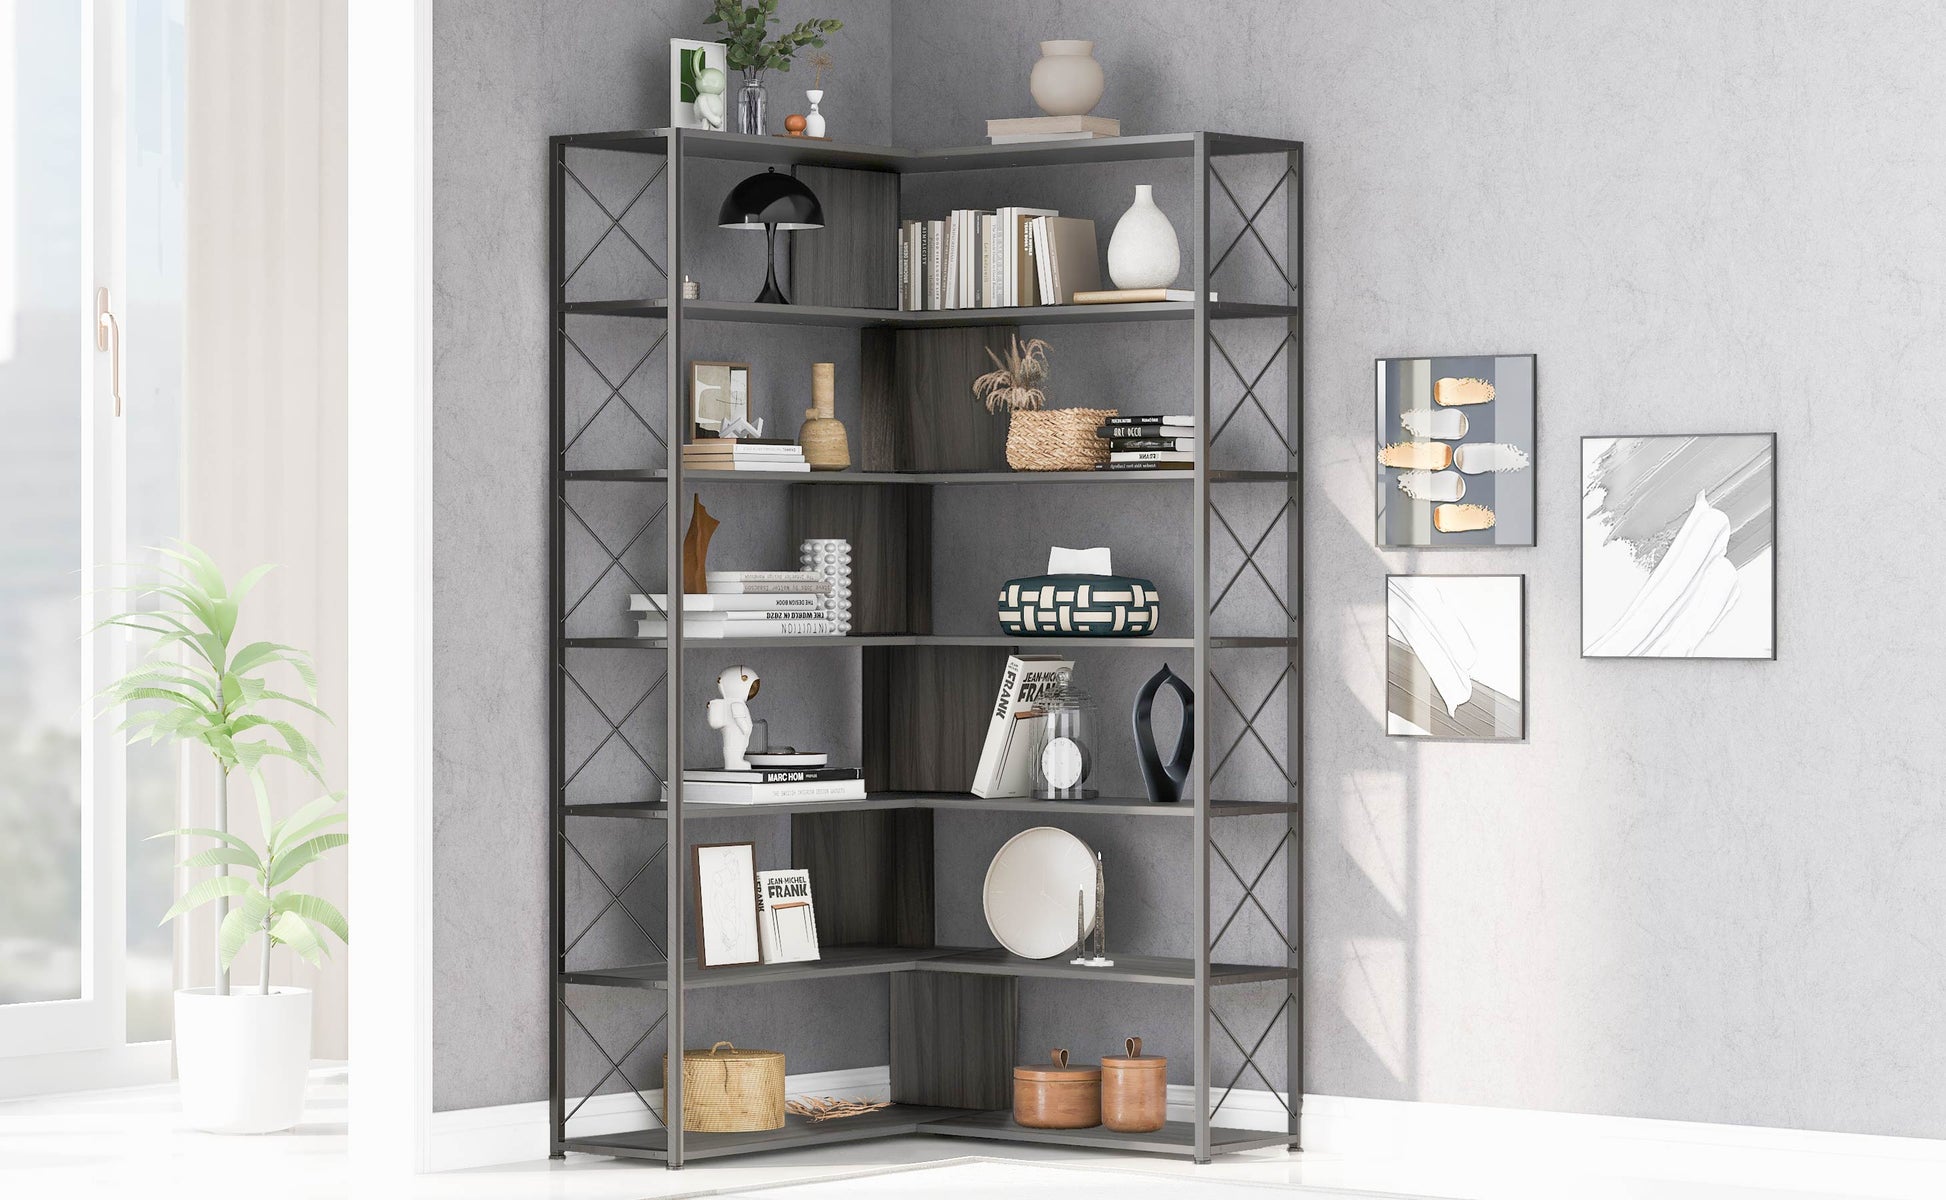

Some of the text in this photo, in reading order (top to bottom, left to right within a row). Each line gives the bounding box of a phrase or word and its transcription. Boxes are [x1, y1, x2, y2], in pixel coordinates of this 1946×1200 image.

[1113, 427, 1142, 437] ART DECO
[766, 611, 825, 619] THE WORLD IN 2020
[781, 622, 827, 634] INTUITION
[995, 670, 1017, 720] FRANK
[767, 772, 788, 783] MARC
[788, 772, 804, 782] HOM
[768, 883, 808, 899] FRANK
